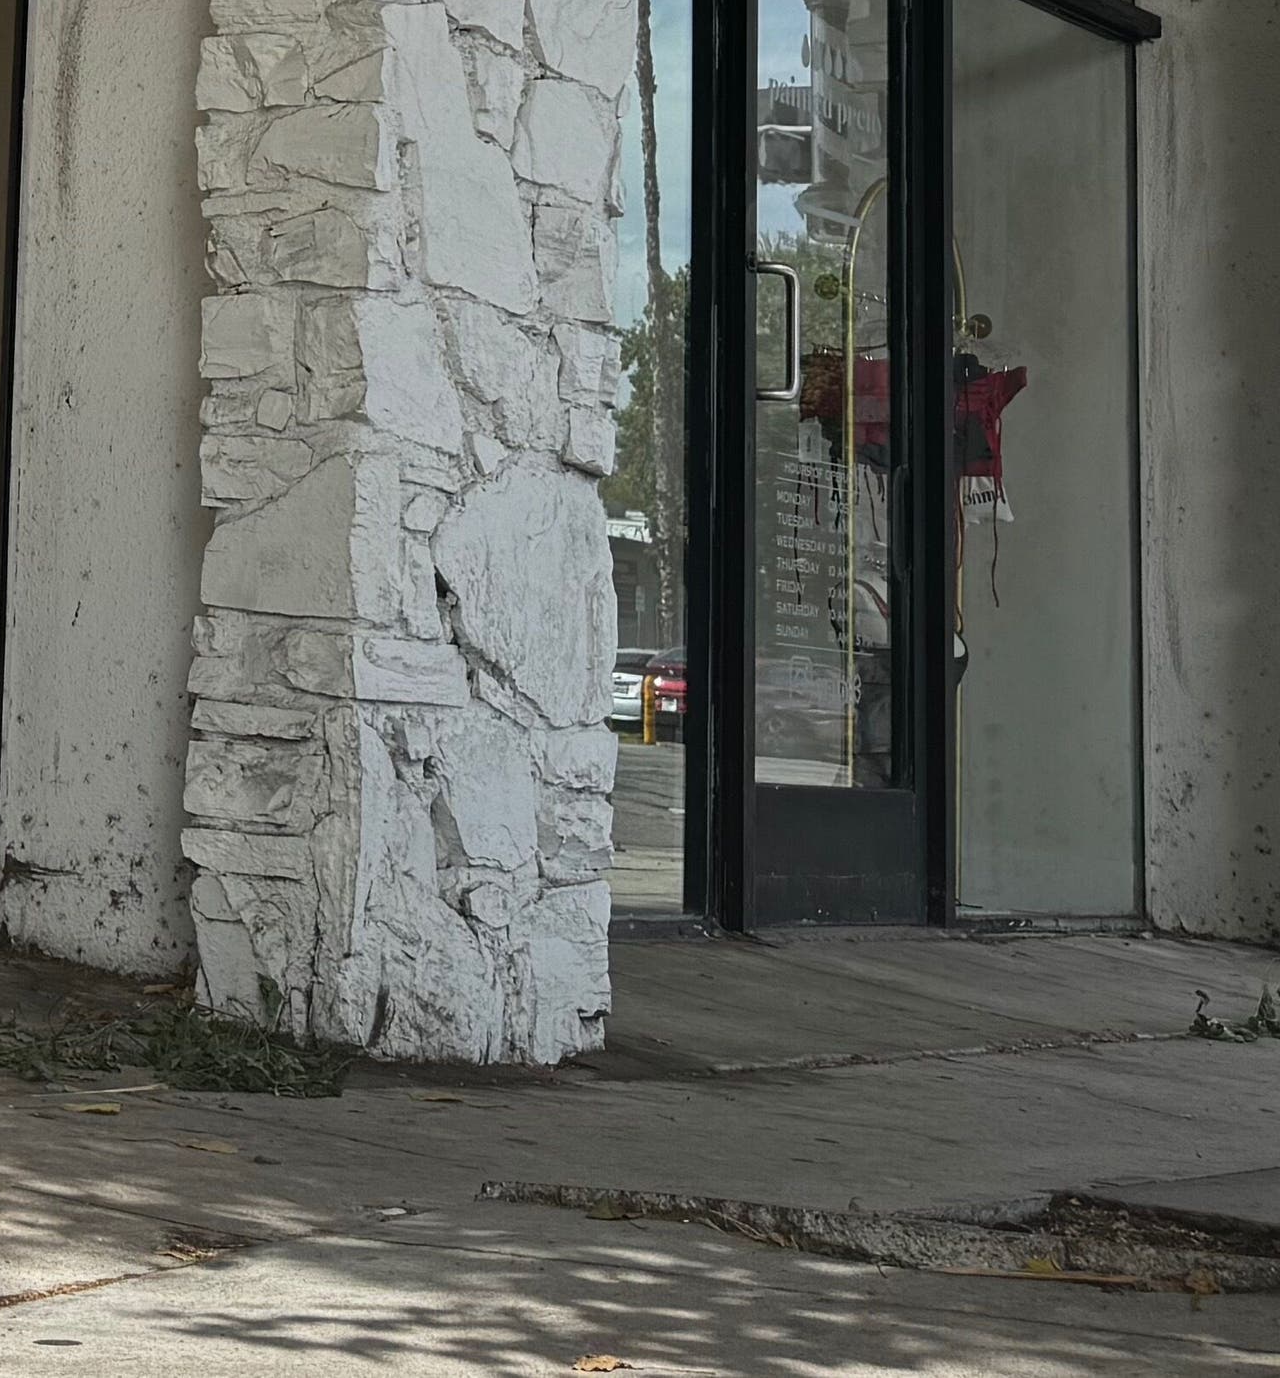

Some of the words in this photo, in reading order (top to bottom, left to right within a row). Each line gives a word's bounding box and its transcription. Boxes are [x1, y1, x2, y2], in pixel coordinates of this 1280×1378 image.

[768, 76, 832, 120] paintd
[776, 489, 811, 506] MONDAY
[776, 511, 814, 530] TUESDAY
[776, 534, 825, 554] WEDNESDAY
[776, 556, 820, 575] THURSDAY
[776, 579, 806, 595] FRIDAY
[776, 601, 820, 618] SATURDAY
[776, 623, 809, 638] SUNDAY
